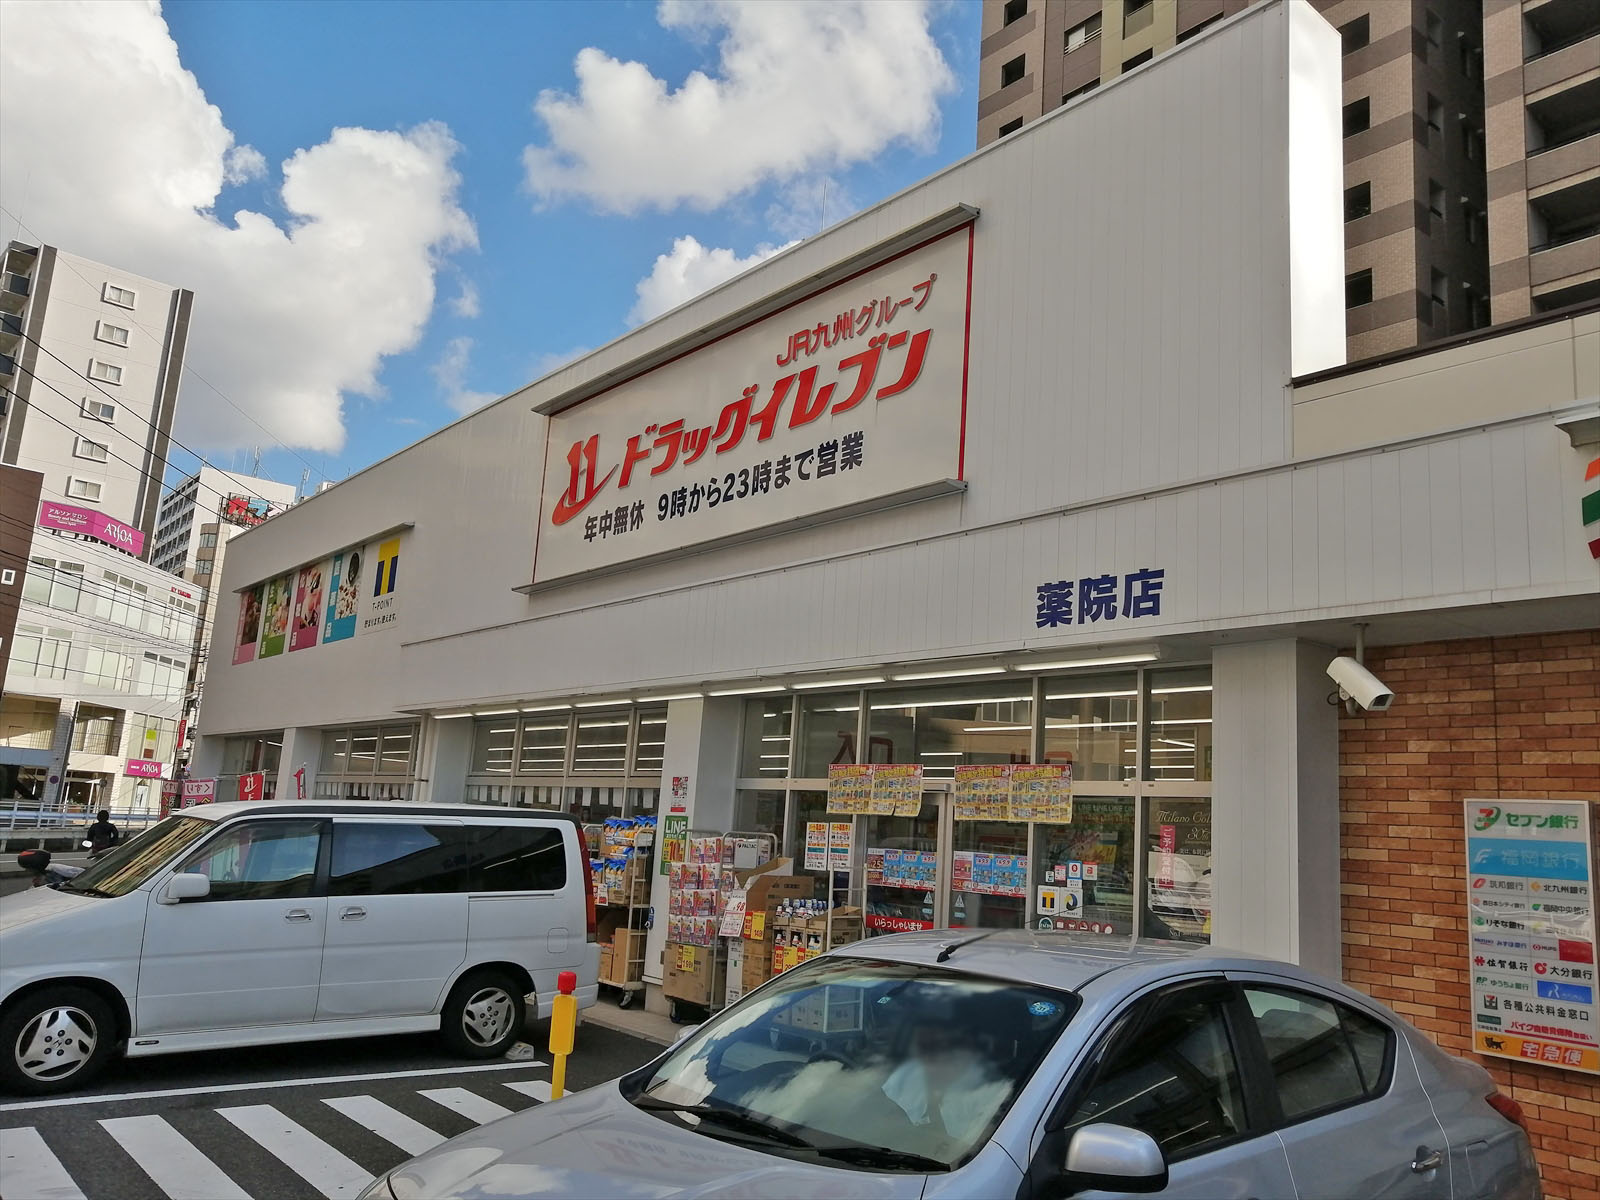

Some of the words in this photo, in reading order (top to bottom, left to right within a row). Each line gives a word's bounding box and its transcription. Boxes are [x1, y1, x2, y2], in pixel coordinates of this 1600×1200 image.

[776, 273, 937, 367] JR九州グループ
[618, 328, 933, 489] ドラッグイレブン
[583, 502, 645, 543] 年中無休
[657, 431, 864, 522] 9時から23時まで営業
[1036, 568, 1164, 628] 薬院店
[1156, 810, 1190, 823] Milano
[1506, 813, 1579, 829] セブン銀行
[665, 820, 686, 834] LINE
[1502, 848, 1580, 869] 福岡銀行
[1543, 884, 1588, 895] 北九州銀行
[874, 918, 923, 931] いらっしゃいませ
[1486, 919, 1525, 930] りそな銀行
[1487, 959, 1529, 971] 佐賀銀行
[1550, 966, 1593, 980] 大分銀行
[1490, 979, 1529, 991] ゆうちょ銀行
[1503, 999, 1589, 1021] 各種公共料金窓口
[1522, 1042, 1583, 1065] 宅急便
